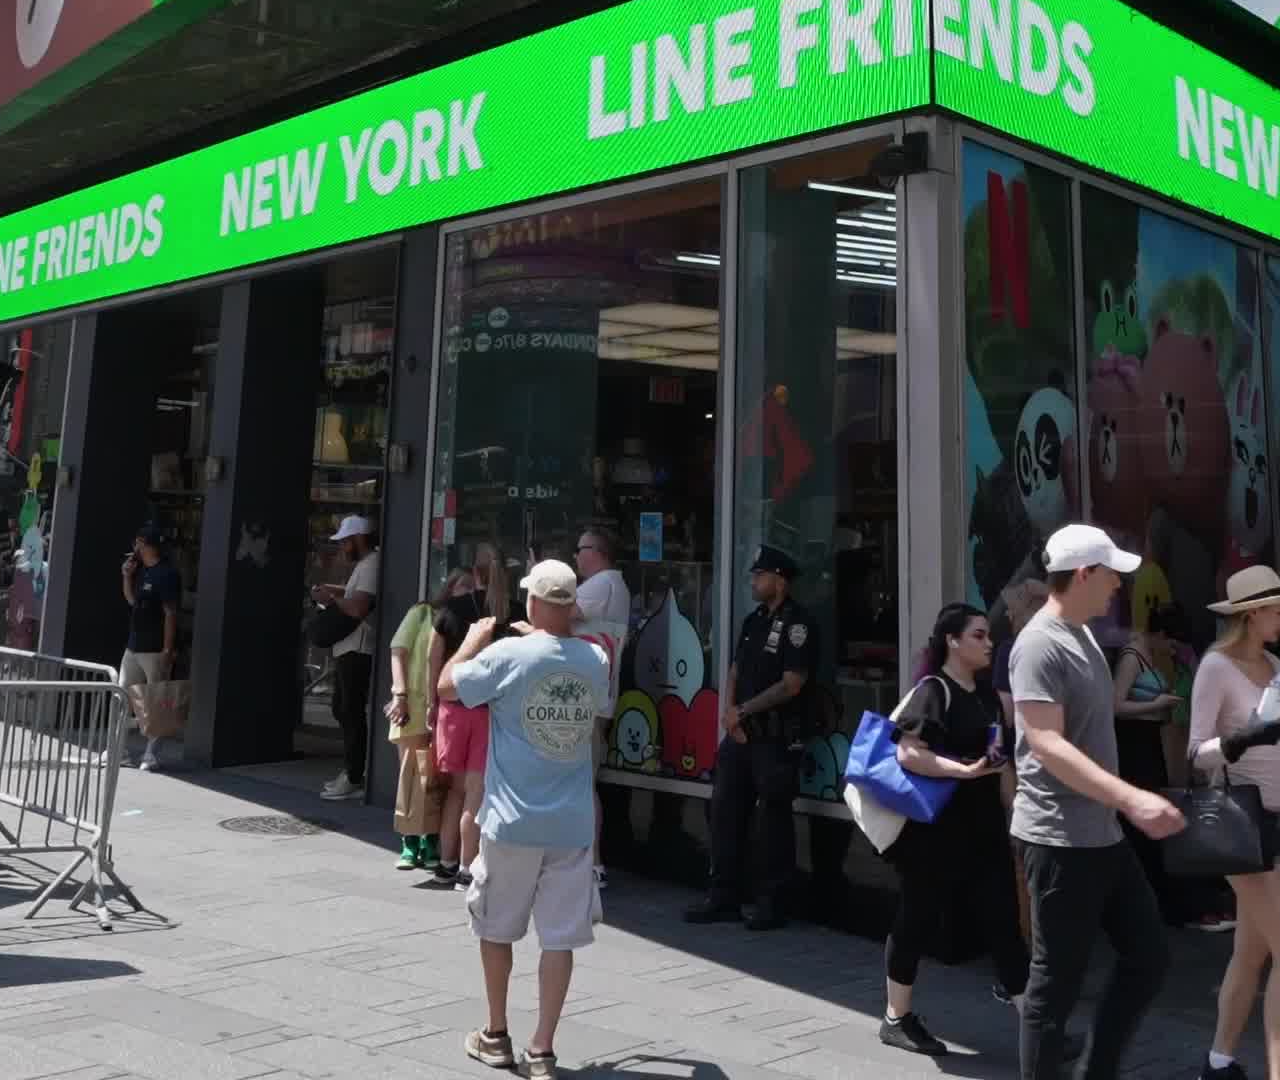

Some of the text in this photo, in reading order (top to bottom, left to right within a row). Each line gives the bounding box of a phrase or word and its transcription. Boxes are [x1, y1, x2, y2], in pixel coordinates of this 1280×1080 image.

[588, 8, 756, 140] LINE
[219, 92, 488, 236] NEW YORK
[1175, 75, 1280, 199] NEW
[30, 194, 165, 285] FRIENDS
[527, 706, 570, 721] CORAL
